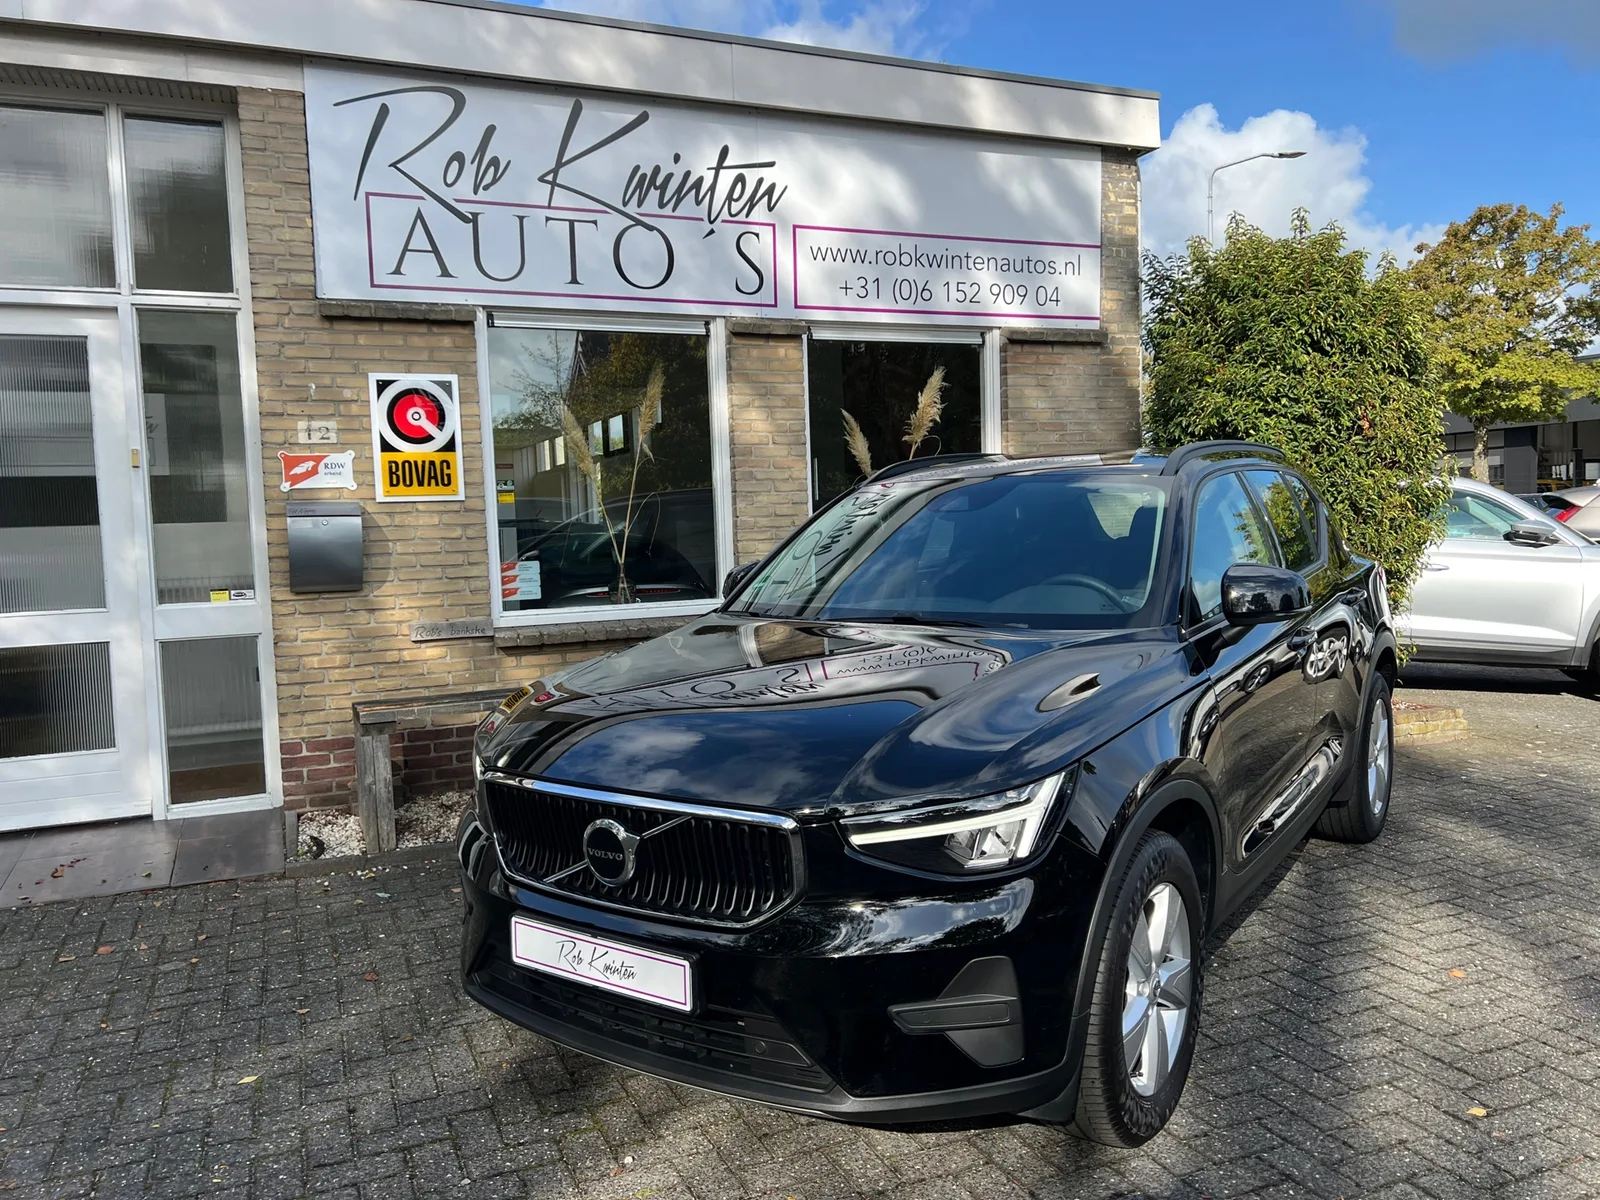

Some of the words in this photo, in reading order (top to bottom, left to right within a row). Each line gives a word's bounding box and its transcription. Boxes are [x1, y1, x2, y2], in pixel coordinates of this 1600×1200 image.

[333, 85, 511, 225] Rob
[537, 98, 788, 232] Kwinten
[810, 243, 1082, 276] www.robkwintenautos.nl
[839, 277, 881, 299] +31
[892, 278, 933, 305] (0)6
[942, 281, 981, 304] 152
[989, 283, 1028, 307] 909
[1035, 285, 1061, 307] 04
[305, 427, 331, 441] 12
[324, 462, 346, 470] RDW
[389, 460, 451, 488] BOVAG
[414, 626, 442, 639] Rob's
[587, 847, 623, 861] VOLVO
[556, 940, 584, 972] Rob
[588, 947, 637, 980] Kwinten
